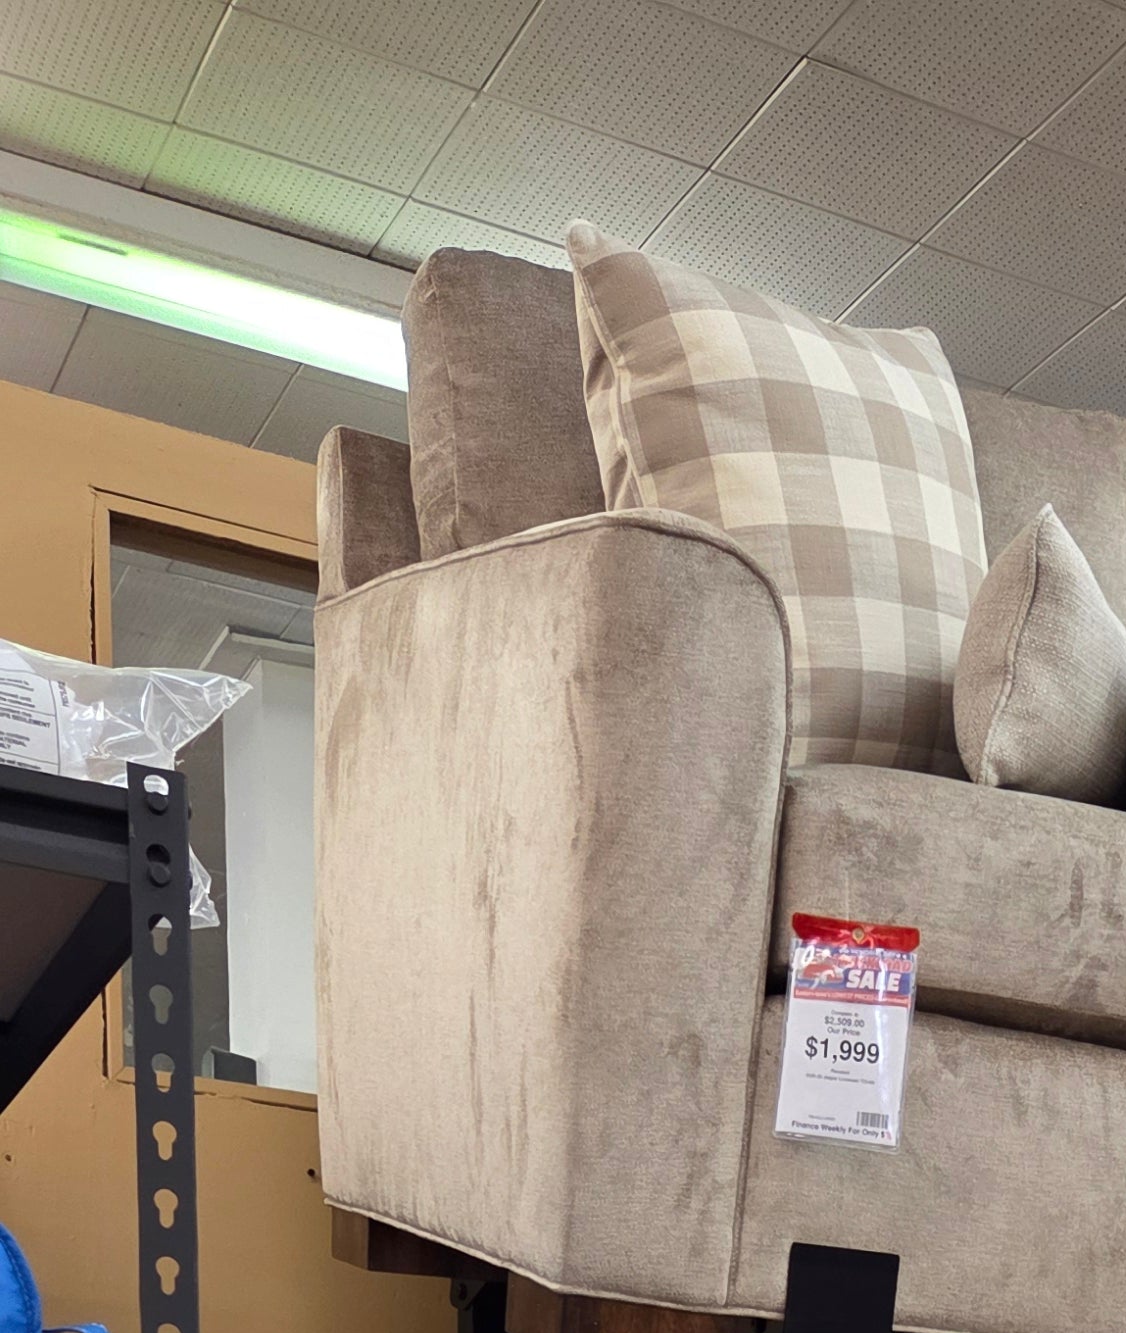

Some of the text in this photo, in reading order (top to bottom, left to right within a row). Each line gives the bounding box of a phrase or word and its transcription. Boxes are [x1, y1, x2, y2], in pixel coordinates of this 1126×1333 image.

[846, 969, 902, 992] SALE
[805, 1035, 880, 1064] $1,999
[791, 1120, 819, 1130] Finance
[820, 1124, 846, 1134] Weekly
[848, 1127, 860, 1135] For
[862, 1129, 879, 1138] Only
